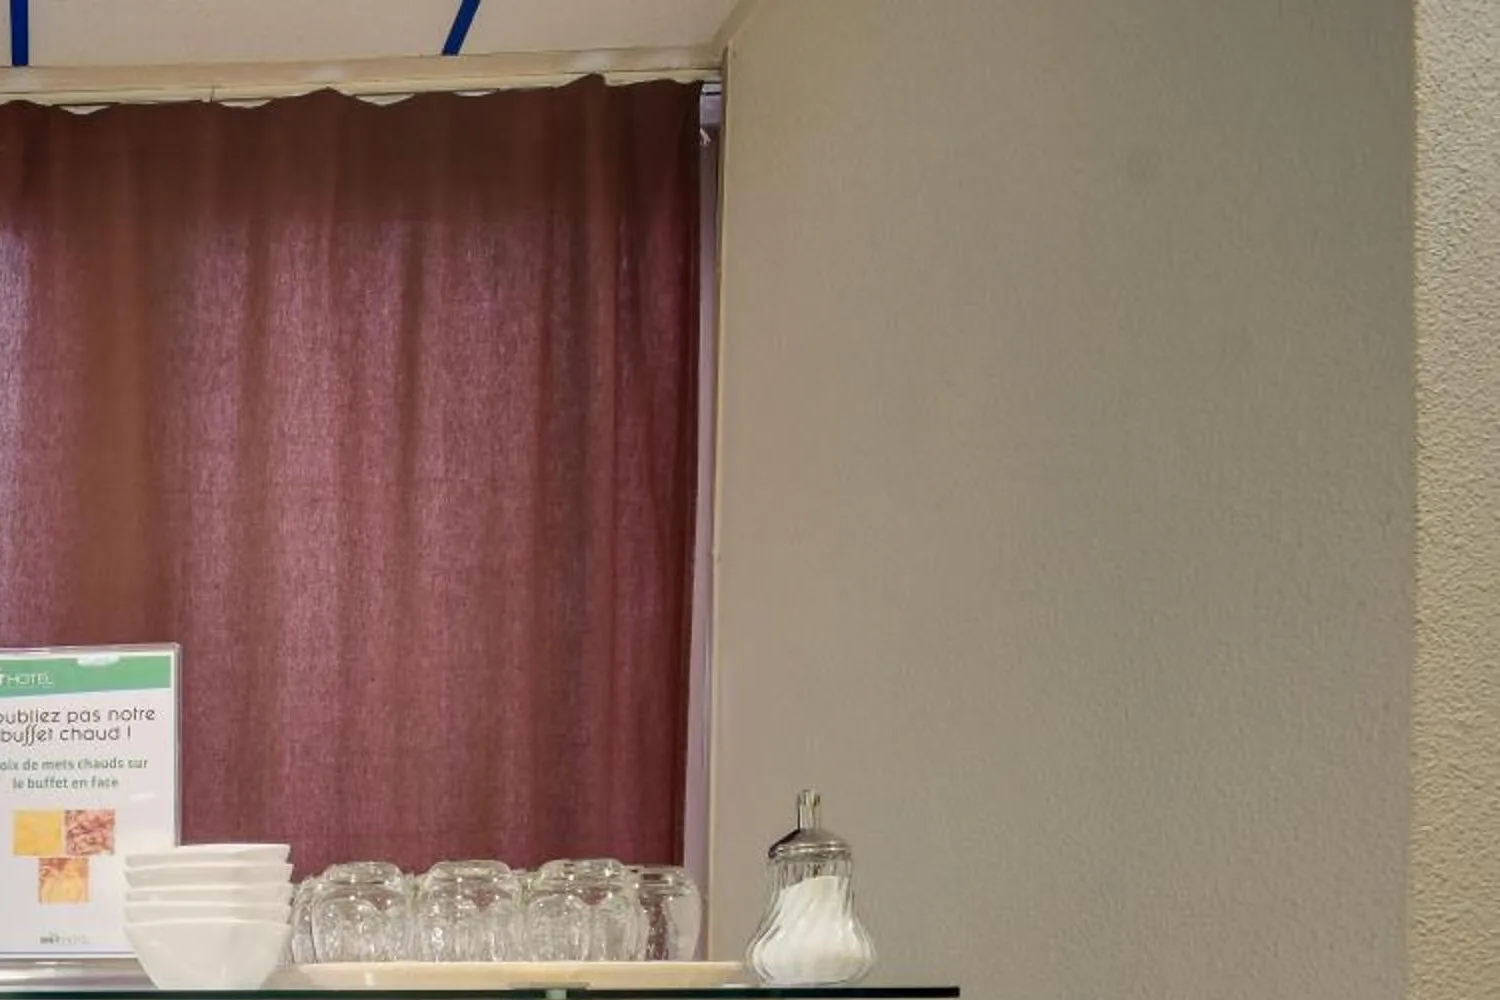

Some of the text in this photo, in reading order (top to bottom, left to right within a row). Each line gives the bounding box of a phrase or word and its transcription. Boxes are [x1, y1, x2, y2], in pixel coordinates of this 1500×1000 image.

[6, 671, 54, 686] HOTEL
[67, 709, 101, 724] pas
[108, 707, 156, 721] notre
[1, 724, 54, 747] buffet
[60, 725, 120, 741] chaud
[23, 758, 39, 771] de
[41, 758, 75, 771] mets
[77, 757, 124, 770] chauds
[127, 758, 149, 769] sur
[12, 775, 119, 789] le buffet en face
